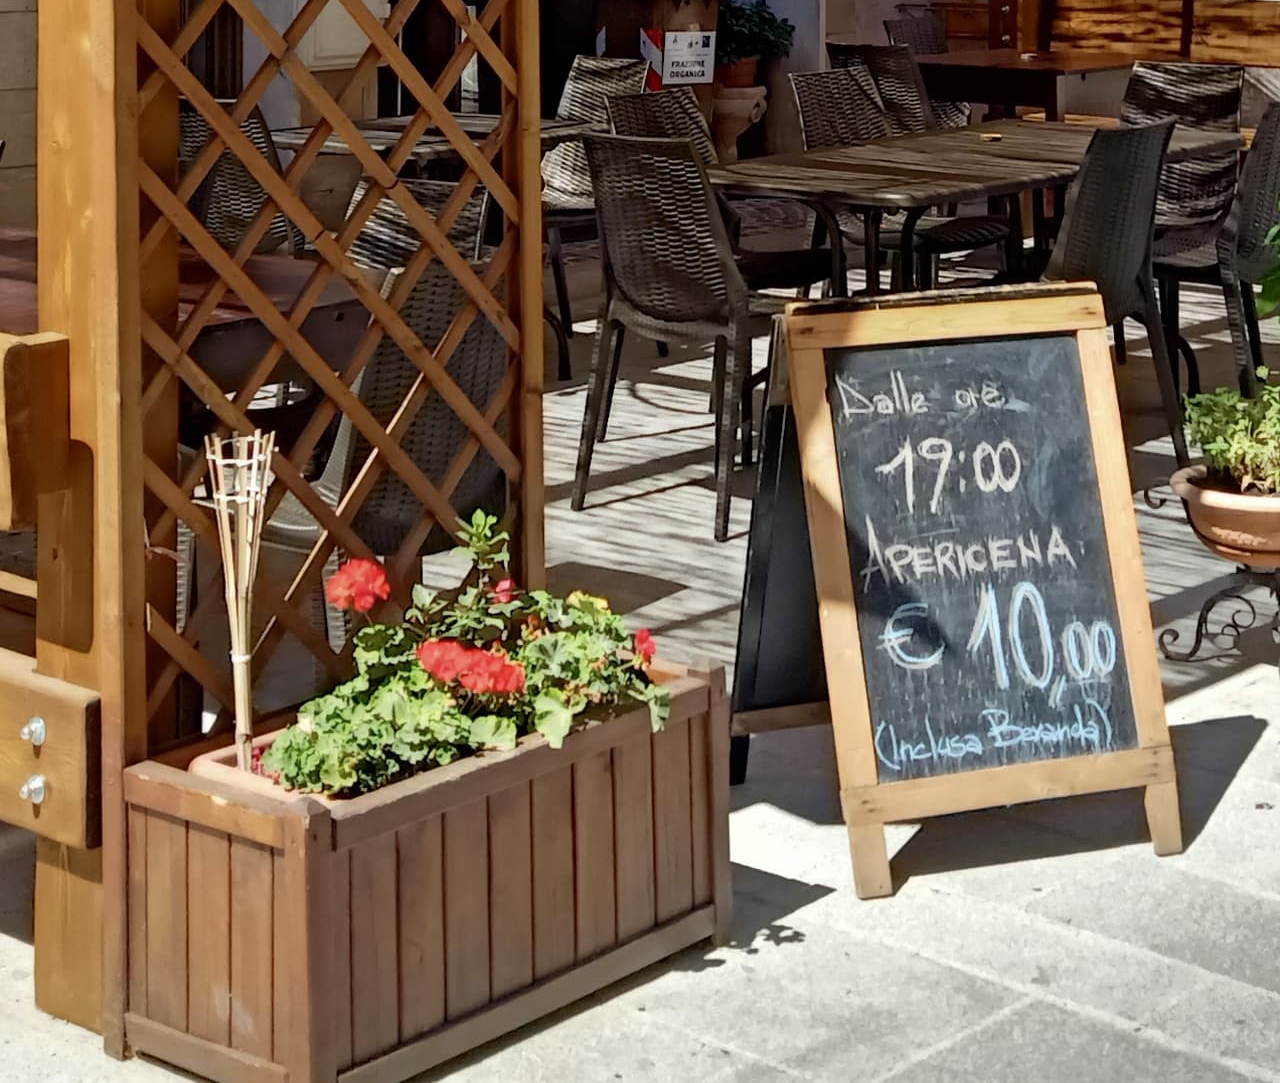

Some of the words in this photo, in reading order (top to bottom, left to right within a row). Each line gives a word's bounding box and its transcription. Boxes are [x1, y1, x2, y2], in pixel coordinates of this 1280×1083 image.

[669, 70, 706, 78] ORGANICA
[835, 369, 929, 417] Dalle
[874, 436, 1021, 514] 19:00
[862, 515, 1078, 592] APERICENA
[876, 603, 946, 670] €
[967, 581, 1116, 708] 10,00
[874, 715, 983, 770] (Inclusa
